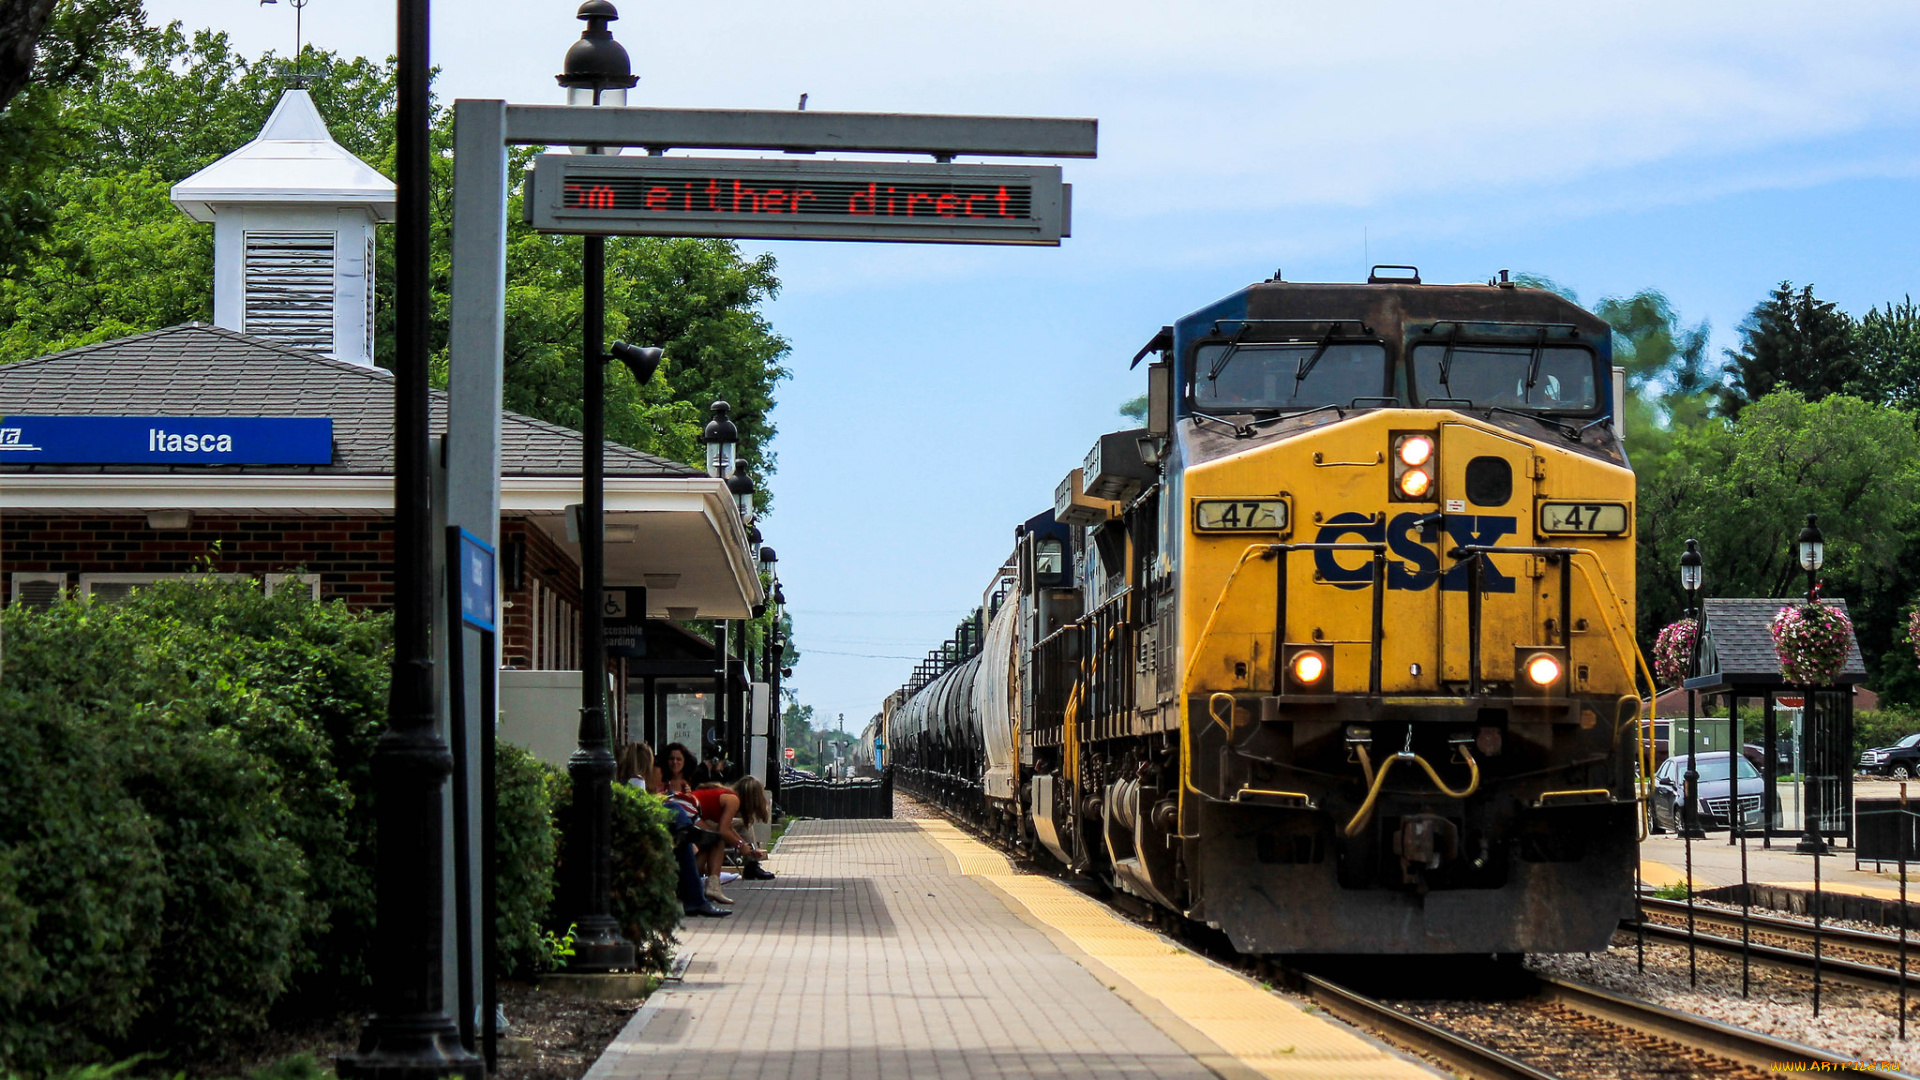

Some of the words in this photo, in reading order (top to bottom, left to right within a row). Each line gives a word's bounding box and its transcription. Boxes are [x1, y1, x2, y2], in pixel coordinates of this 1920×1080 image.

[646, 178, 817, 214] either
[849, 182, 1016, 219] direct
[149, 428, 233, 452] Itasca
[1221, 503, 1260, 528] 47
[1565, 505, 1602, 531] 47
[1314, 511, 1517, 594] CSX
[603, 625, 643, 635] ccessible
[603, 637, 636, 648] oarding
